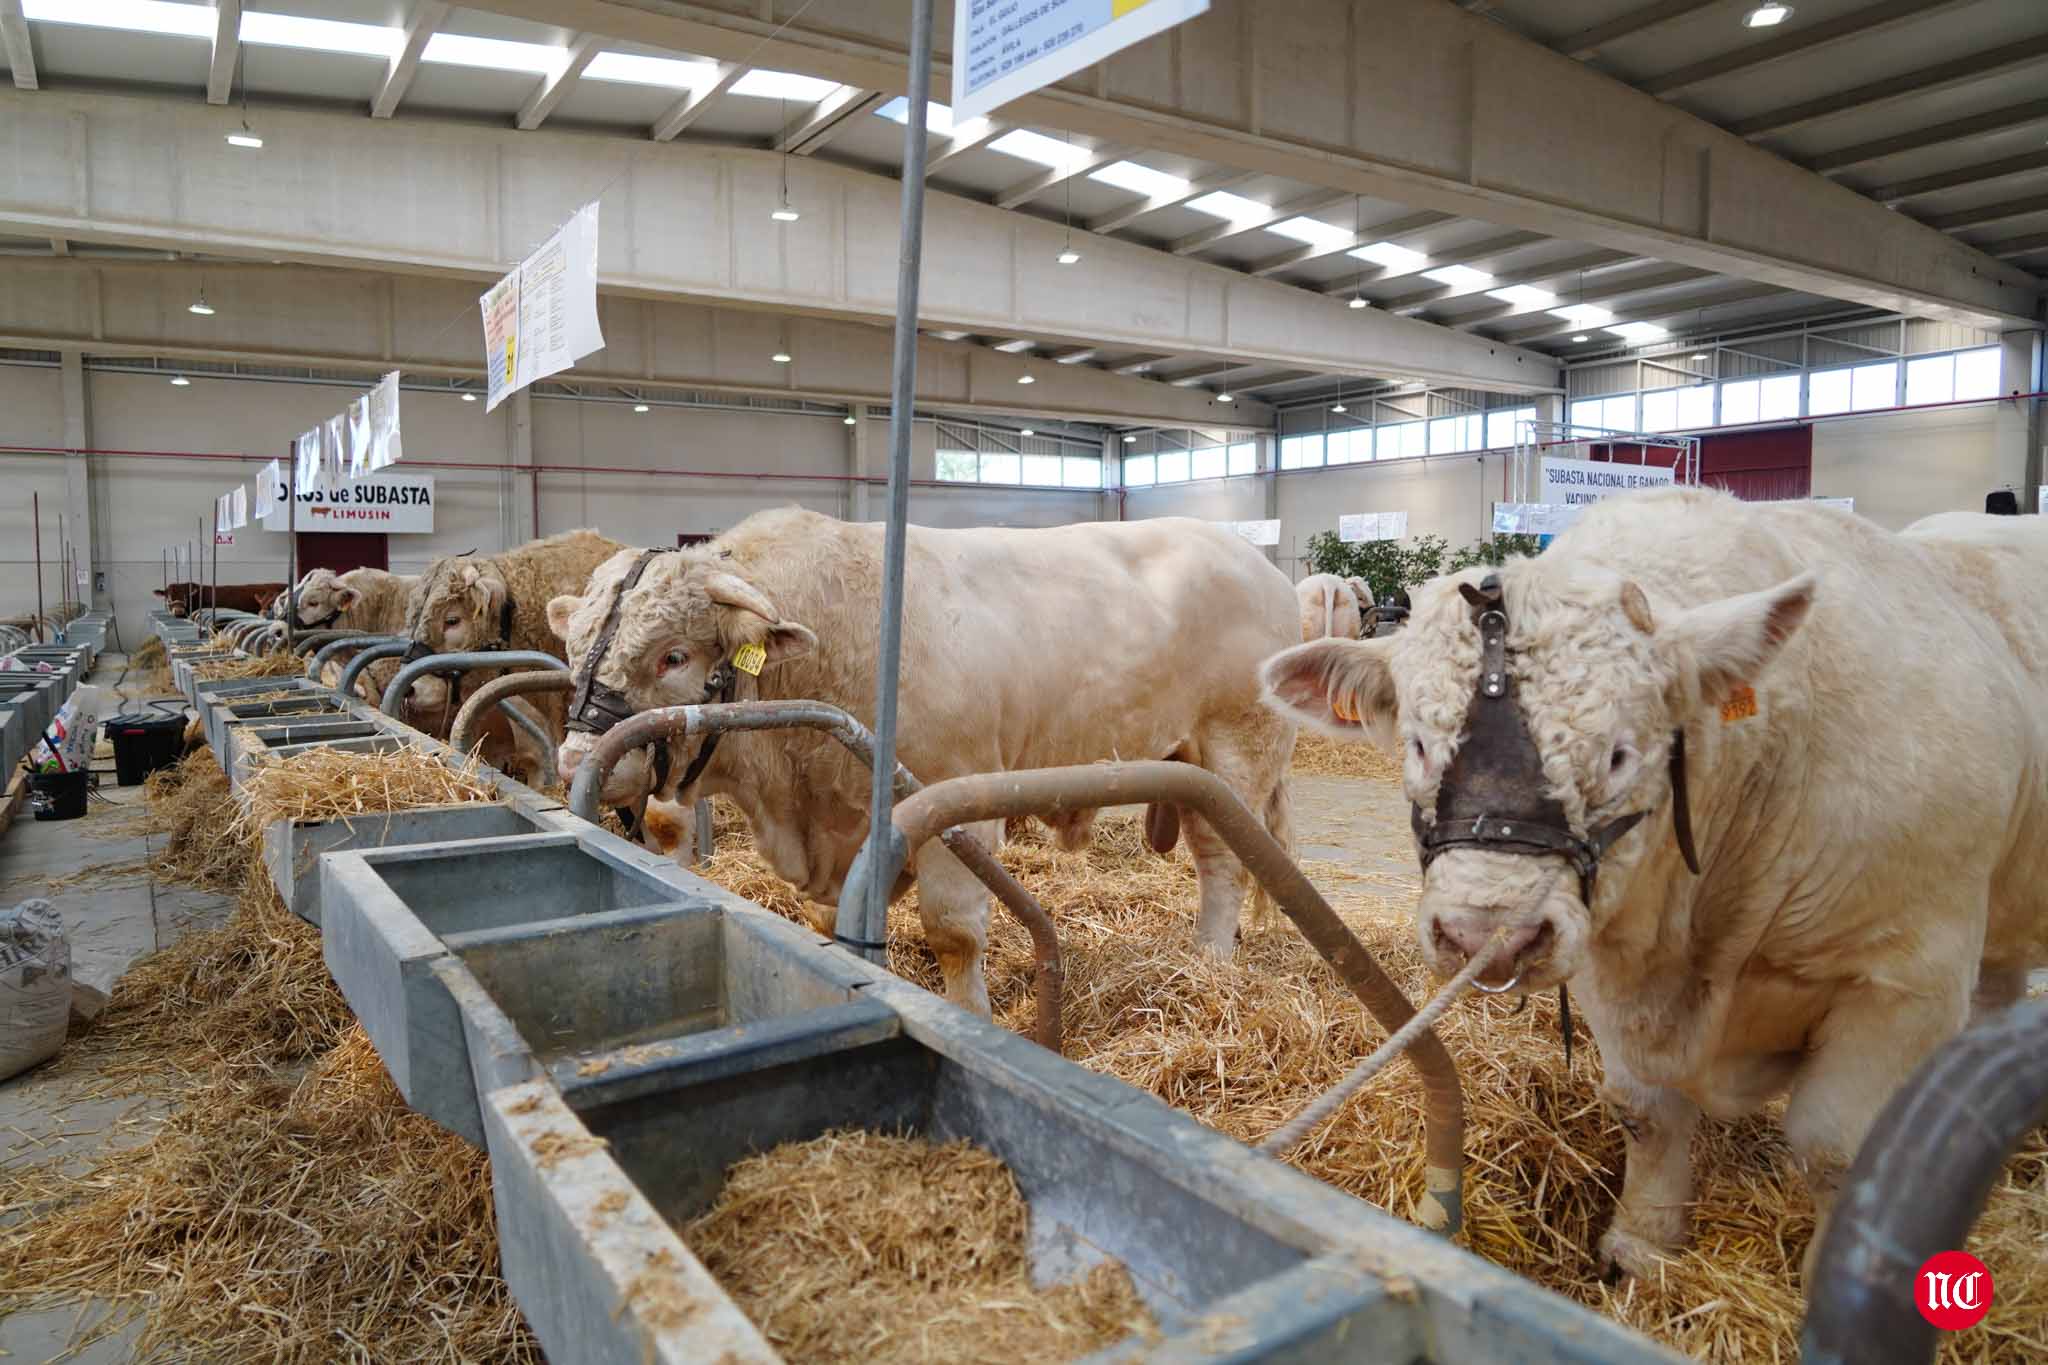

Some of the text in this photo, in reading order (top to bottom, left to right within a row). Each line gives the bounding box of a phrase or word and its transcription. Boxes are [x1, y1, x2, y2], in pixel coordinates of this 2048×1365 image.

[1587, 471, 1625, 488] NACIONAL
[1627, 475, 1637, 489] DE
[354, 484, 431, 505] SUBASTA
[332, 509, 390, 521] LIMUSIN
